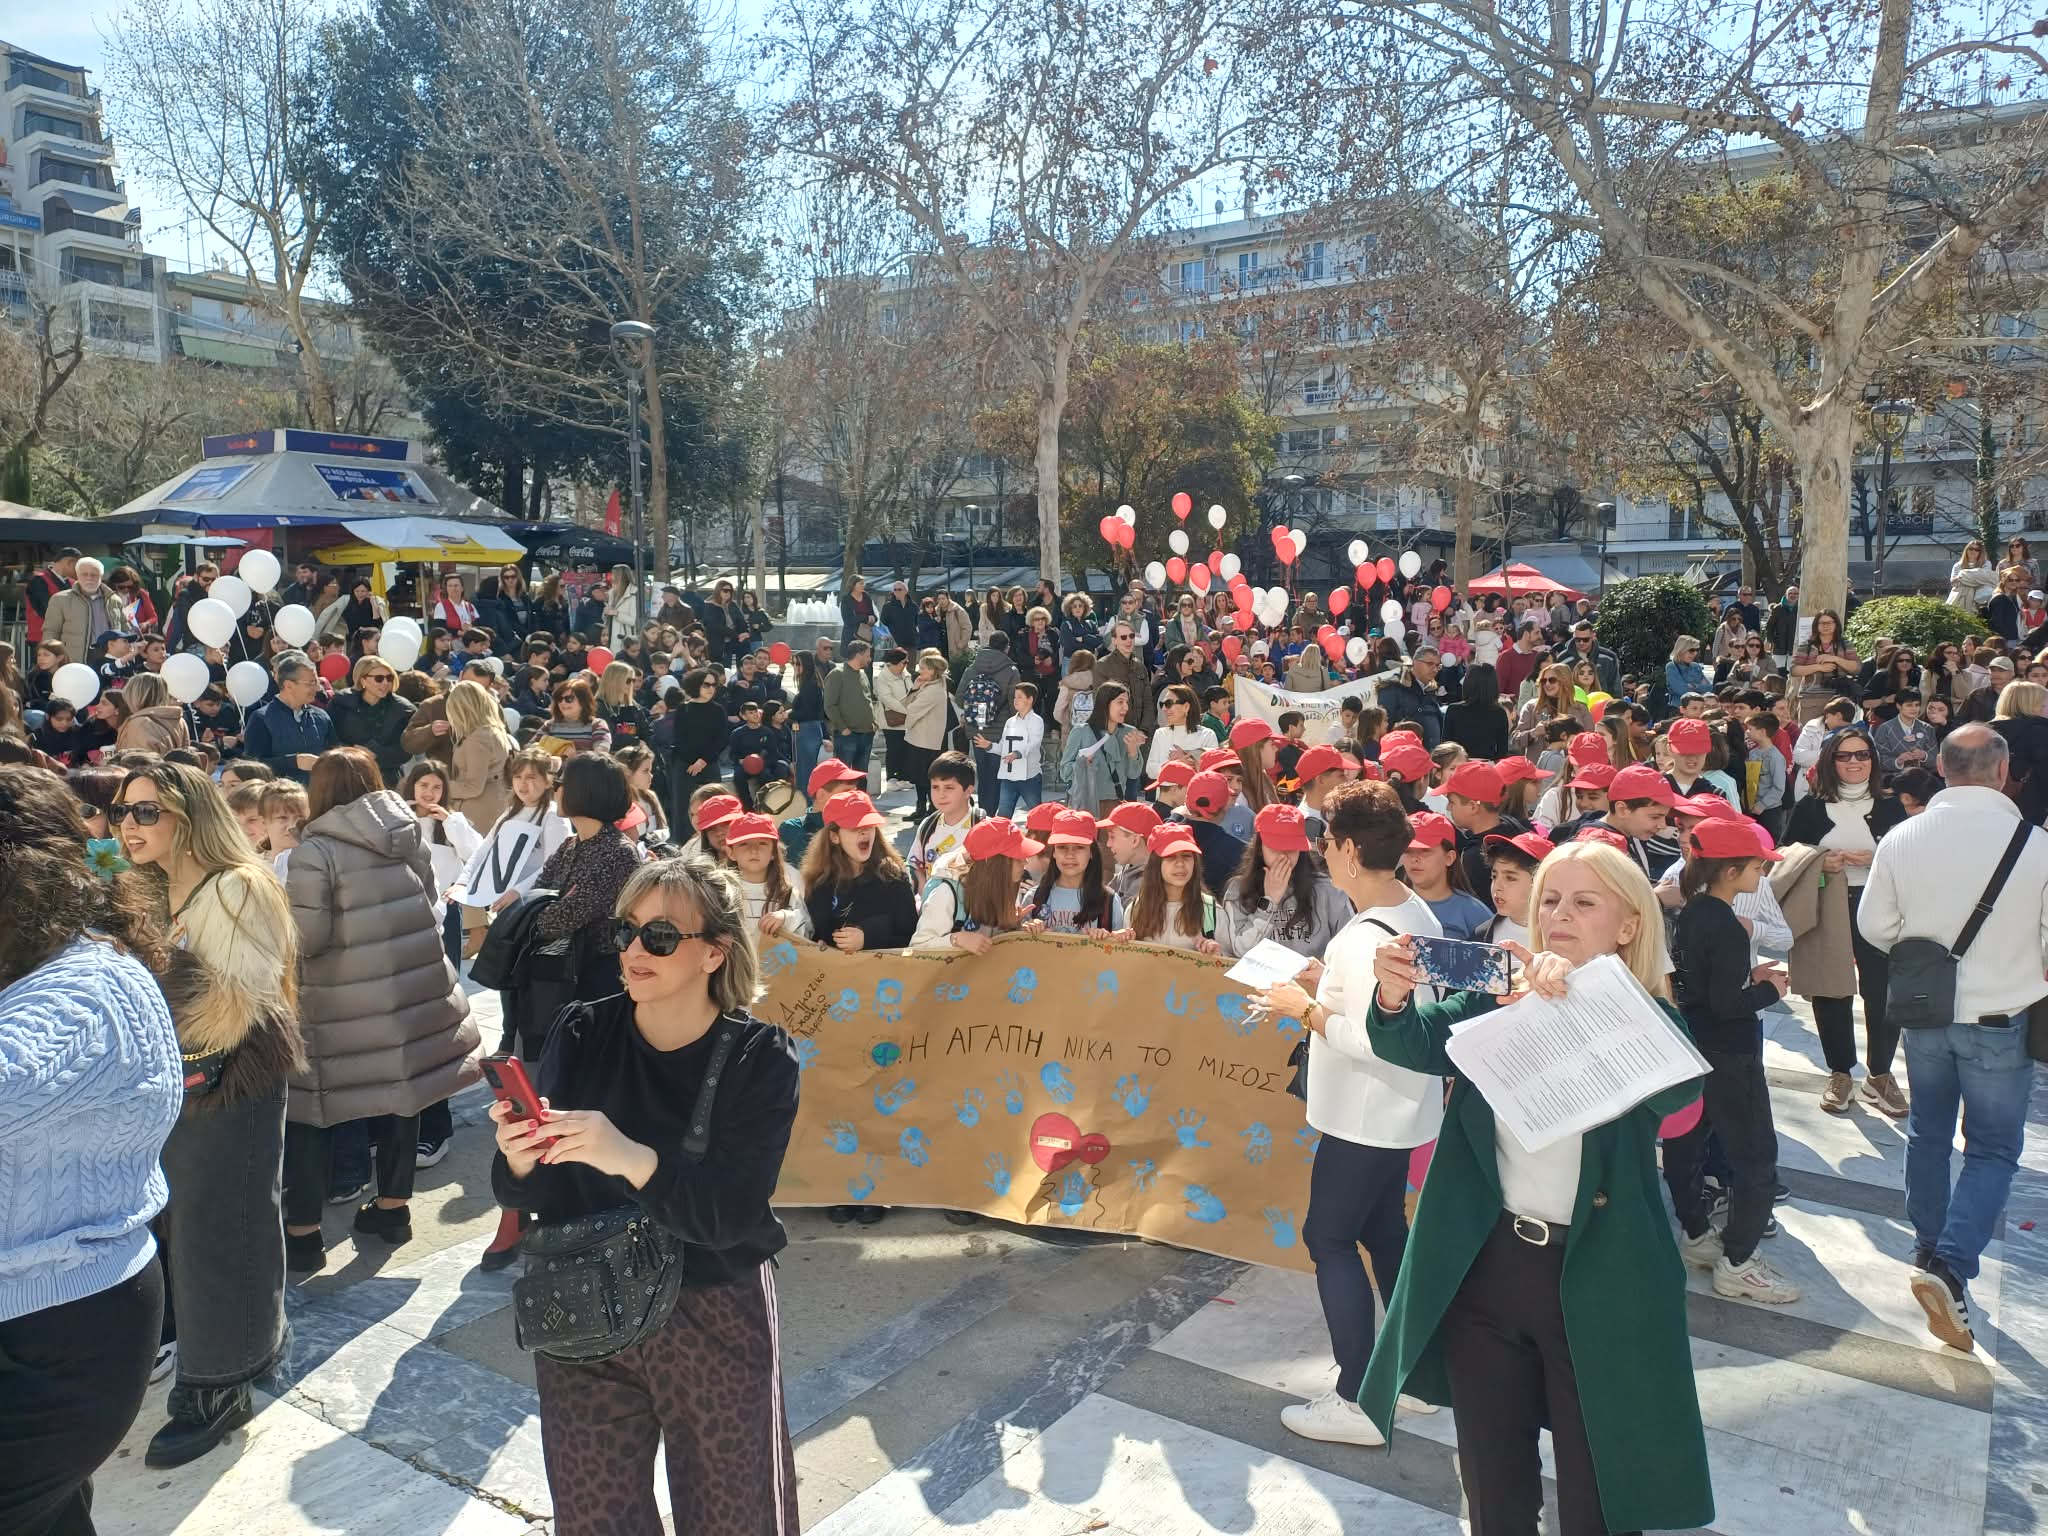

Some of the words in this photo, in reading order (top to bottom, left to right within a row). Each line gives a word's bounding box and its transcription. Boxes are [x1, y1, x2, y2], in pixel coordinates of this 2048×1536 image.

[909, 1031, 929, 1062] Η
[946, 1024, 1043, 1058] ΑΓΑΠΗ
[1063, 1036, 1113, 1062] ΝΙΚΑ
[1137, 1045, 1172, 1067] ΤΟ
[1198, 1055, 1281, 1093] ΜΙΣΟΣ
